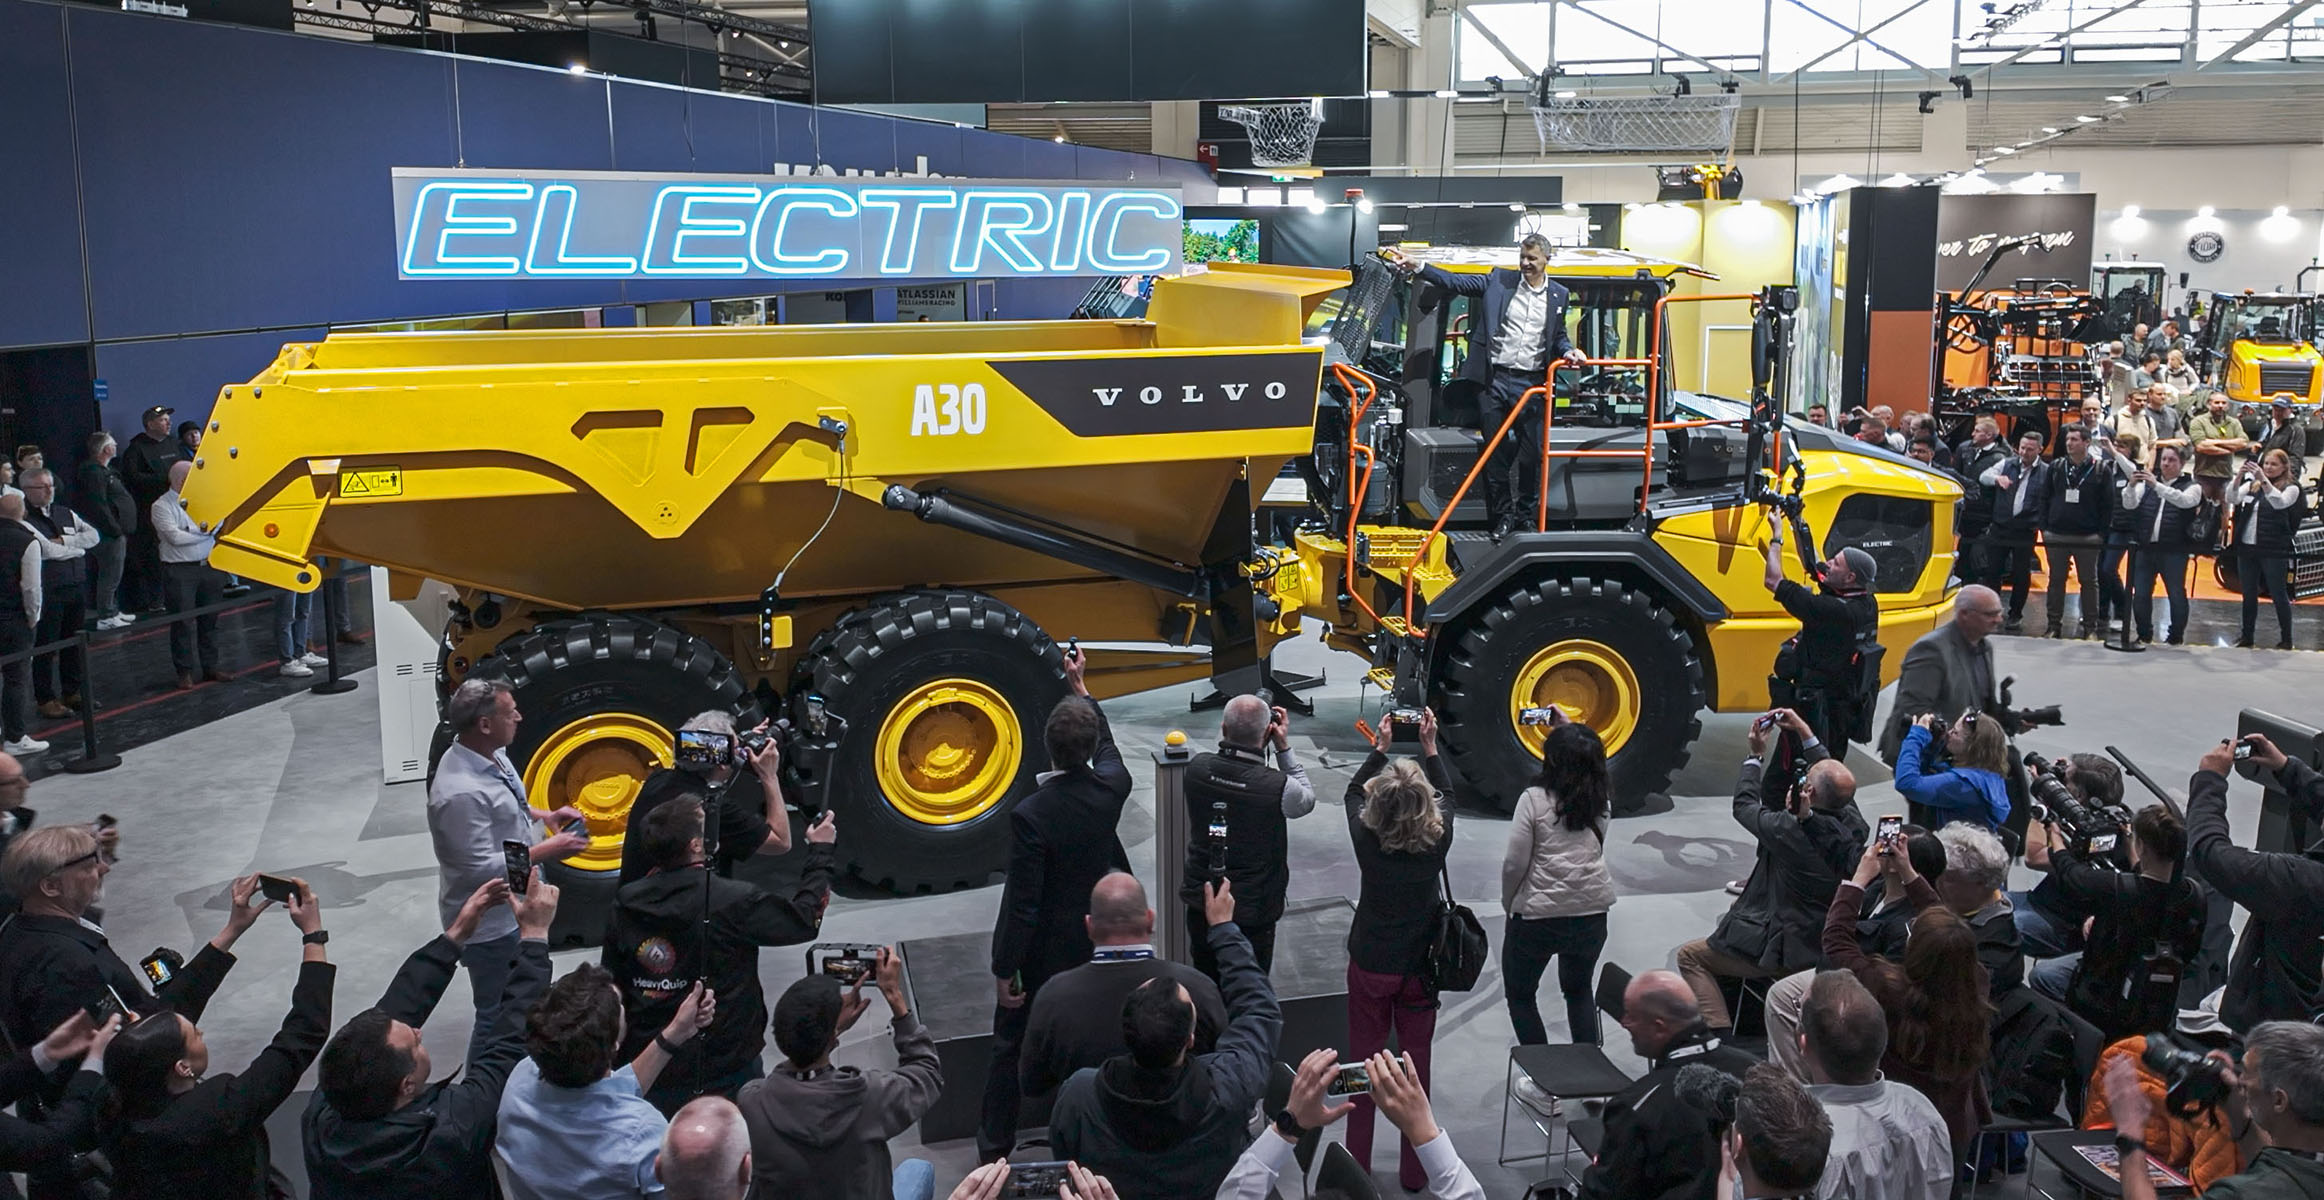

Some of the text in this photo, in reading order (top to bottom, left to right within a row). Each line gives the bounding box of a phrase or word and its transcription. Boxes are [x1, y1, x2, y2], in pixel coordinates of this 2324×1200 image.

[402, 182, 1180, 275] ELECTRIC
[1968, 233, 1998, 256] to
[1997, 230, 2075, 255] pfrm
[1092, 381, 1287, 406] VOLVO
[910, 383, 988, 437] A30
[1712, 445, 1772, 454] VOLO
[632, 977, 688, 991] HeavyQuip
